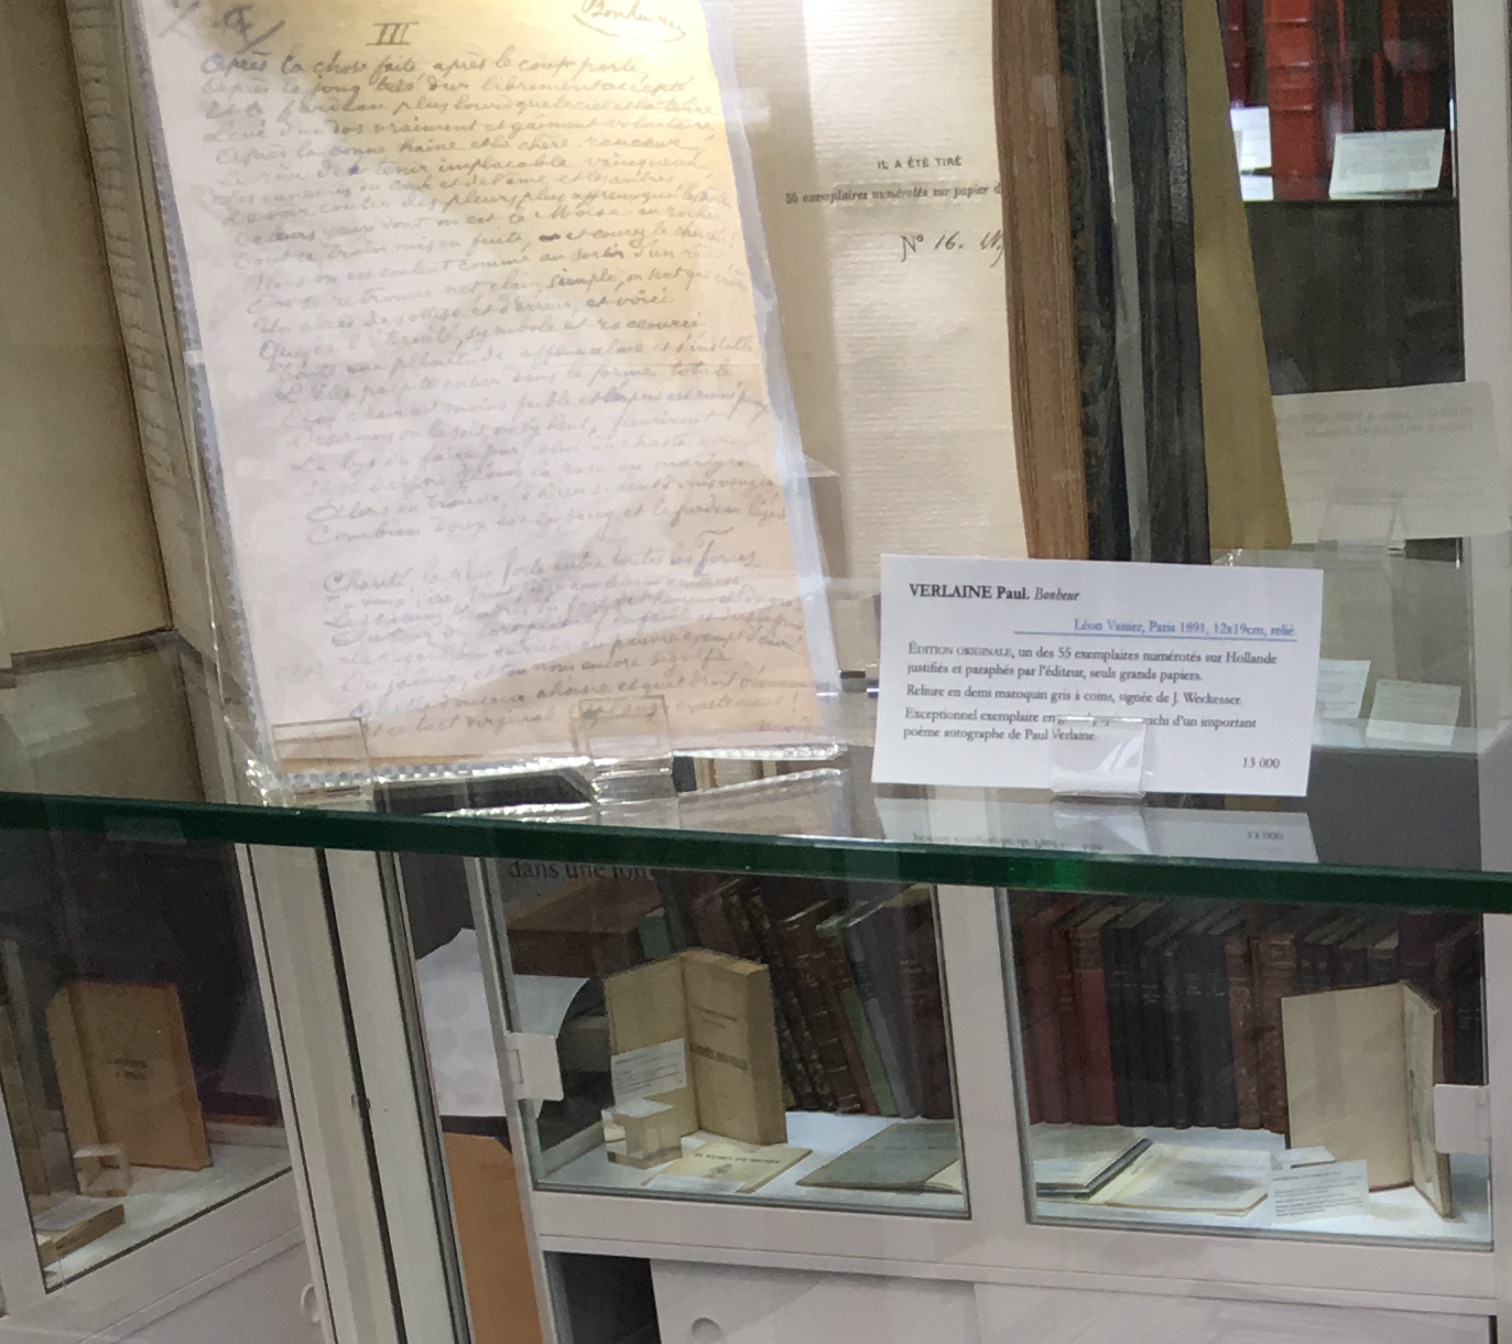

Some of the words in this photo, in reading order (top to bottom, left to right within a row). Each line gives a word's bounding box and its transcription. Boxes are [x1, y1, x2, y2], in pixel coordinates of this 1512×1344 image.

[877, 160, 889, 170] IL
[894, 160, 902, 169] A
[907, 156, 930, 169] ÉTÉ
[935, 154, 963, 168] TIRÉ
[954, 184, 989, 199] papier
[909, 583, 993, 600] VERLAINE
[996, 585, 1031, 600] Paul.
[1017, 648, 1033, 658] un
[1035, 645, 1055, 659] des
[1058, 646, 1072, 659] 55
[1073, 648, 1140, 664] exemplaires
[1225, 650, 1278, 665] Hollande
[907, 661, 949, 675] justifiés
[951, 665, 962, 675] et
[964, 663, 1015, 680] paraphés
[1016, 667, 1037, 680] par
[1089, 666, 1117, 679] seuls
[1118, 667, 1158, 683] grands
[943, 727, 1005, 743] autographe
[1007, 727, 1022, 740] de
[1024, 728, 1049, 741] Paul
[1242, 756, 1256, 769] 13
[1258, 757, 1281, 770] 000
